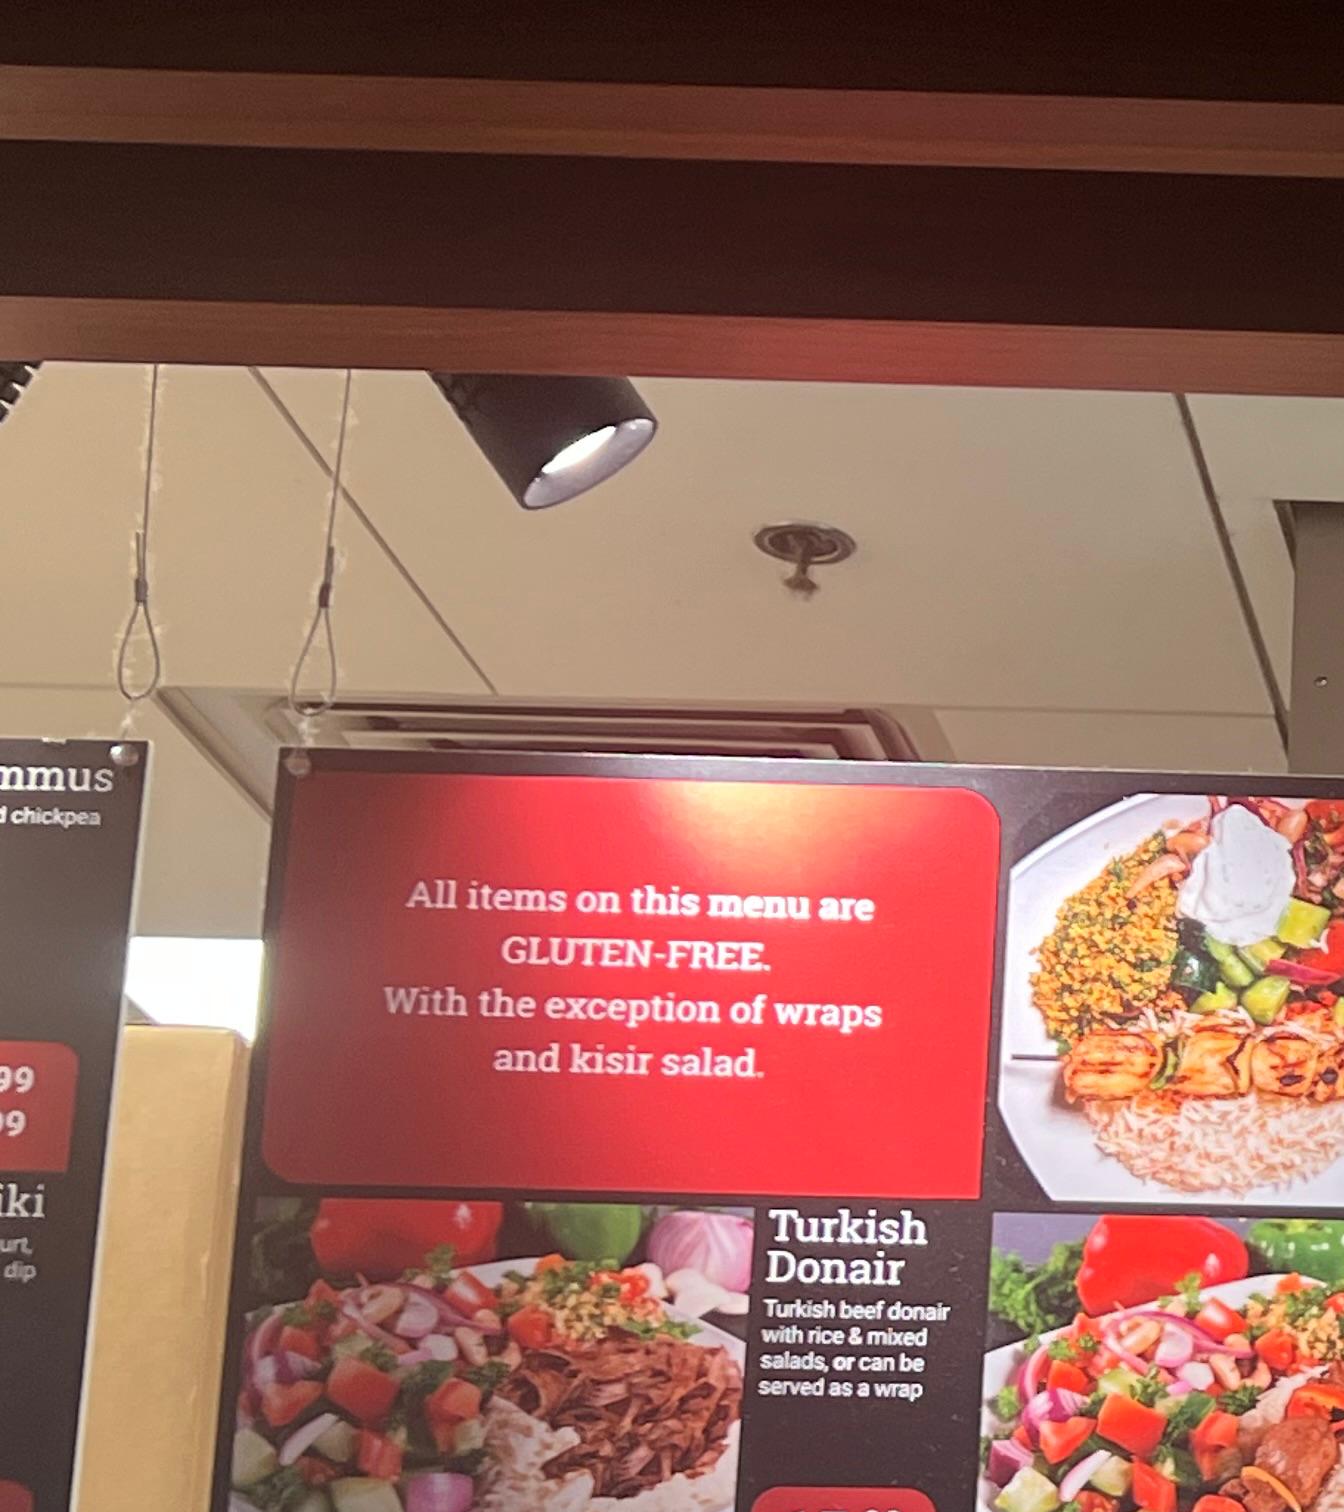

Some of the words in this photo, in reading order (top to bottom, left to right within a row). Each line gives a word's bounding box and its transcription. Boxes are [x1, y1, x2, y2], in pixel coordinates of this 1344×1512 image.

[10, 806, 101, 829] chickpea
[407, 880, 457, 909] All
[467, 881, 567, 913] items
[575, 891, 622, 914] on
[630, 884, 701, 917] this
[706, 893, 812, 921] menu
[817, 896, 876, 922] are
[502, 936, 772, 972] GLUTEN-FREE.
[385, 987, 468, 1016] With
[479, 987, 536, 1018] the
[545, 991, 721, 1029] exception
[729, 993, 768, 1025] of
[773, 1002, 883, 1035] wraps
[494, 1042, 561, 1073] and
[569, 1043, 654, 1076] kisir
[660, 1046, 765, 1078] salad.
[768, 1208, 929, 1246] Turkish
[765, 1250, 906, 1286] Donair
[762, 1298, 836, 1319] Turkish
[839, 1299, 886, 1320] beef
[886, 1300, 951, 1321] donair
[761, 1324, 804, 1344] with
[807, 1325, 846, 1345] rice
[847, 1326, 863, 1346] &
[866, 1327, 928, 1347] mixed
